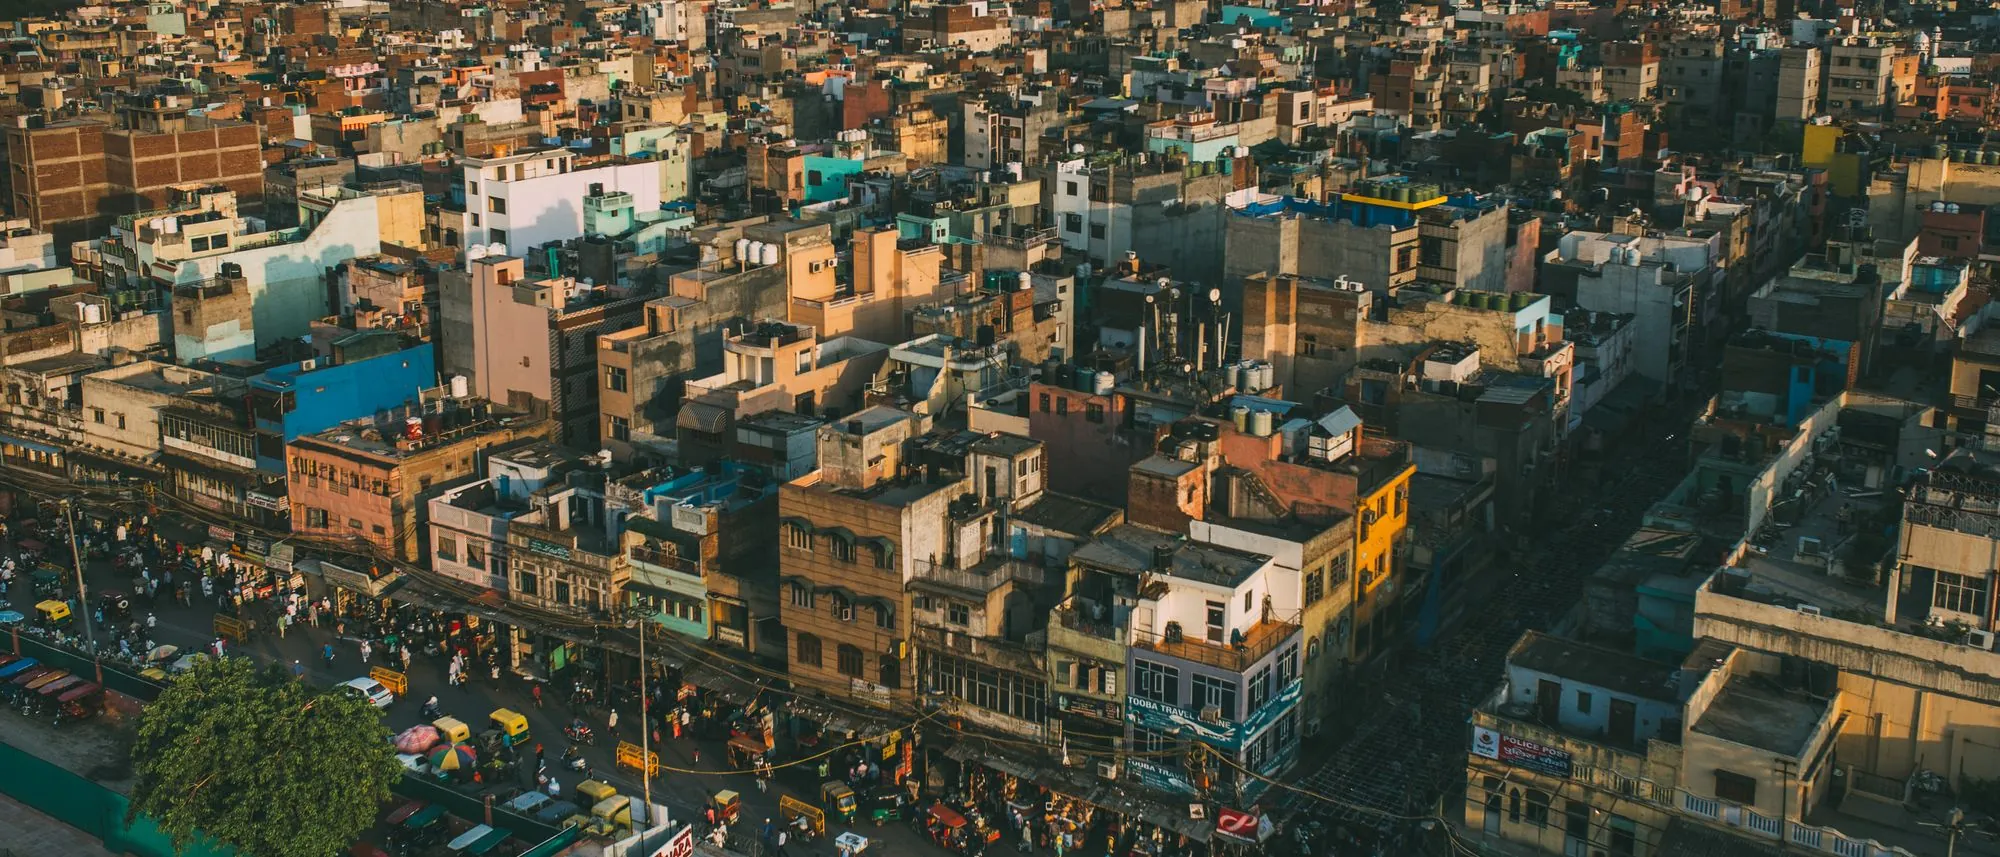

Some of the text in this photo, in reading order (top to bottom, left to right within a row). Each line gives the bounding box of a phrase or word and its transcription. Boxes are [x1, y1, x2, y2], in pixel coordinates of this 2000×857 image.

[1127, 696, 1158, 711] TOOBA
[1160, 704, 1195, 720] TRAVEL
[1503, 735, 1540, 751] POLICE
[1542, 746, 1569, 759] POST
[1127, 757, 1156, 772] TOOBA
